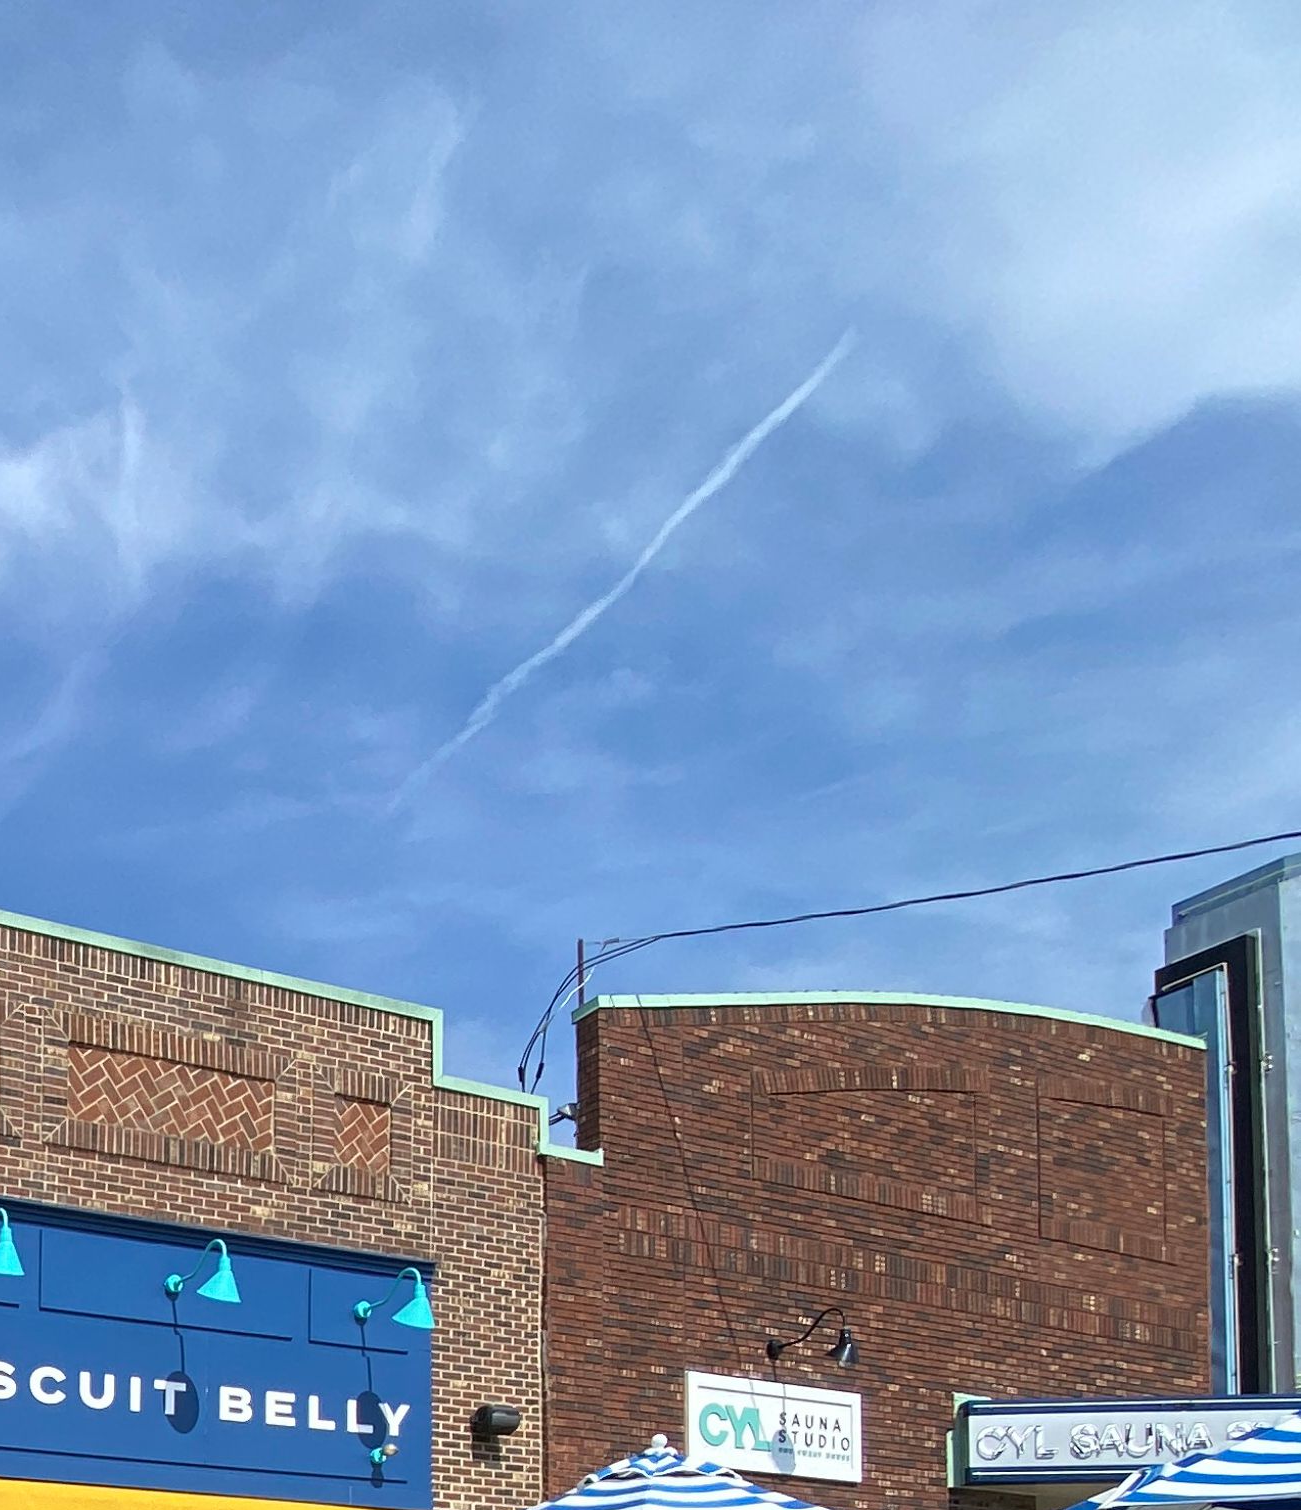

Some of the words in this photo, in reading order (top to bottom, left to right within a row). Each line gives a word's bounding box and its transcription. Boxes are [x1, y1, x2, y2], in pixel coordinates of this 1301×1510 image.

[218, 1385, 411, 1437] BELLY
[699, 1402, 772, 1453] CYL
[778, 1411, 842, 1433] SAUNA
[778, 1428, 851, 1452] STUDIO
[975, 1423, 1060, 1461] CYL
[1069, 1421, 1215, 1461] SAUNA
